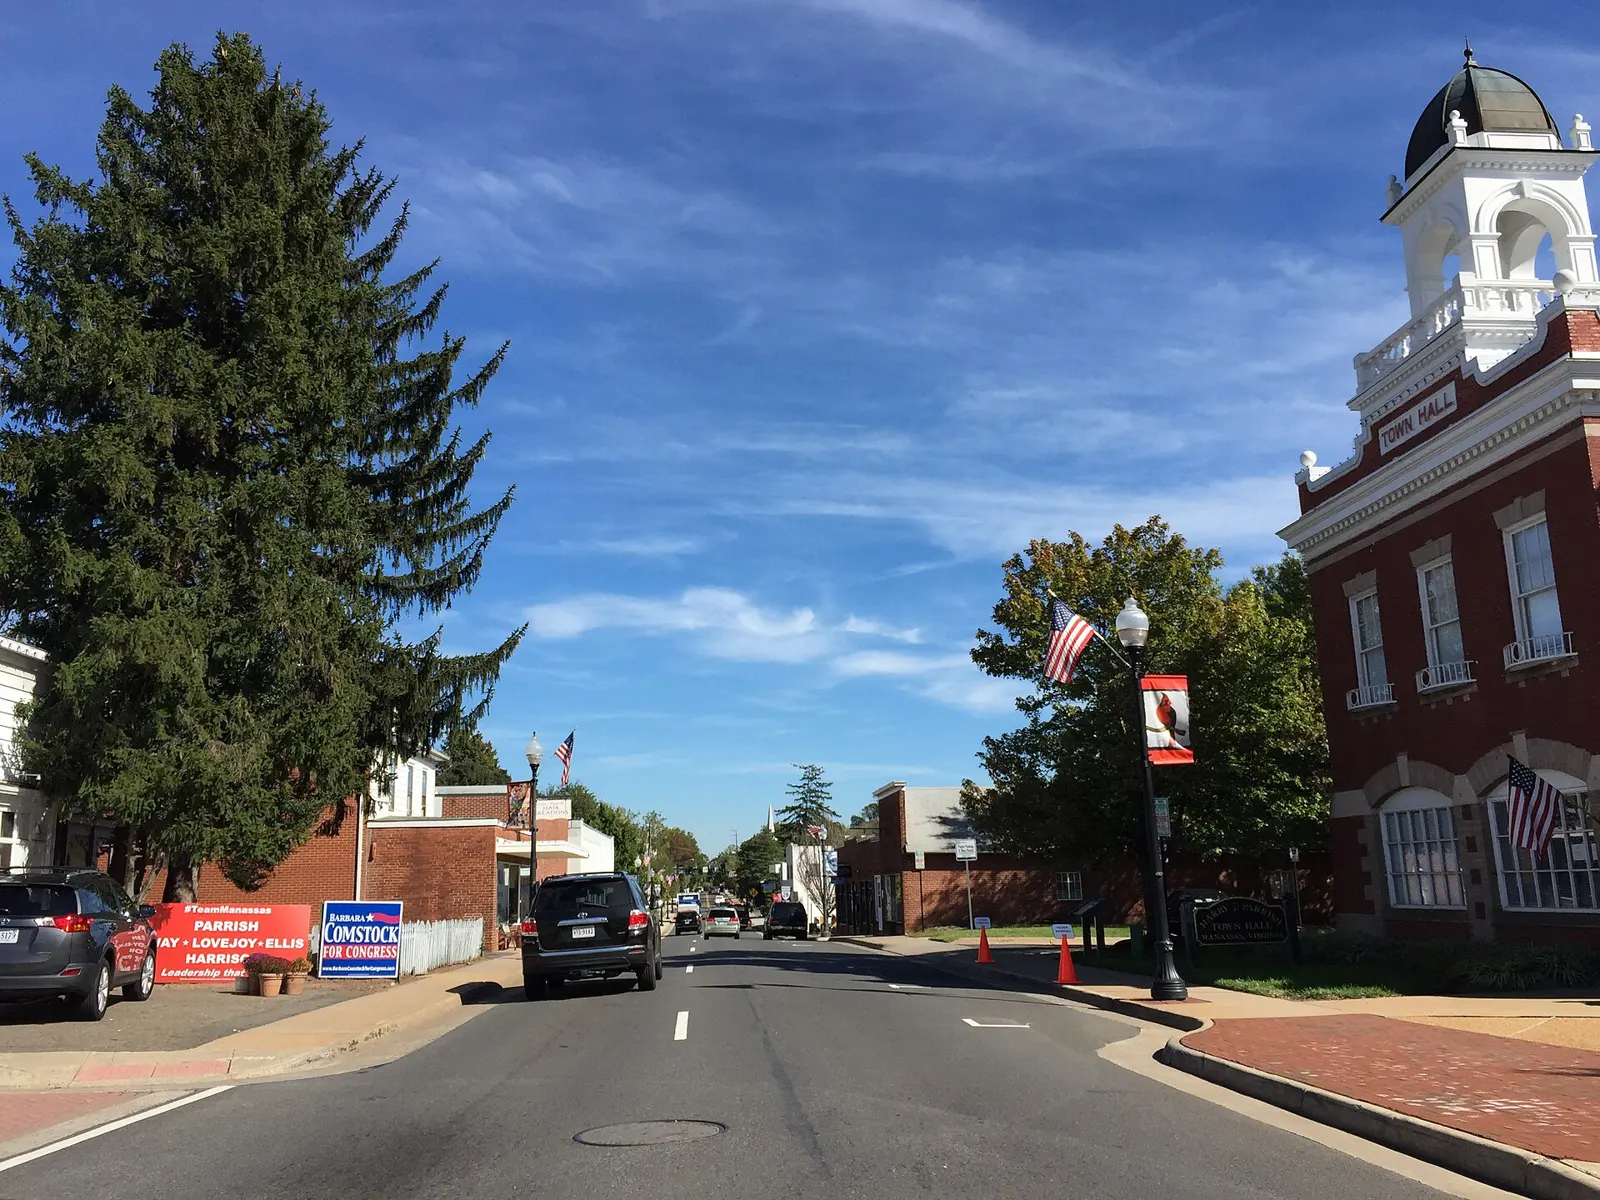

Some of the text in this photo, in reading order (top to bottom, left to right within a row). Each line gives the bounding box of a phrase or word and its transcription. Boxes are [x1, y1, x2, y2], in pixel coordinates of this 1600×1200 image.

[1381, 392, 1454, 447] TOWN HALL
[184, 905, 271, 914] #TeamManassas
[330, 913, 365, 922] BARBARA
[194, 921, 259, 932] PARRISH
[1211, 922, 1272, 931] TOWN HALL
[325, 922, 399, 943] COMSTOCK
[192, 938, 255, 949] LOVEJOY
[265, 939, 304, 949] ELLIS
[323, 945, 397, 958] FOR CONGRESS
[161, 969, 220, 979] Leadership
